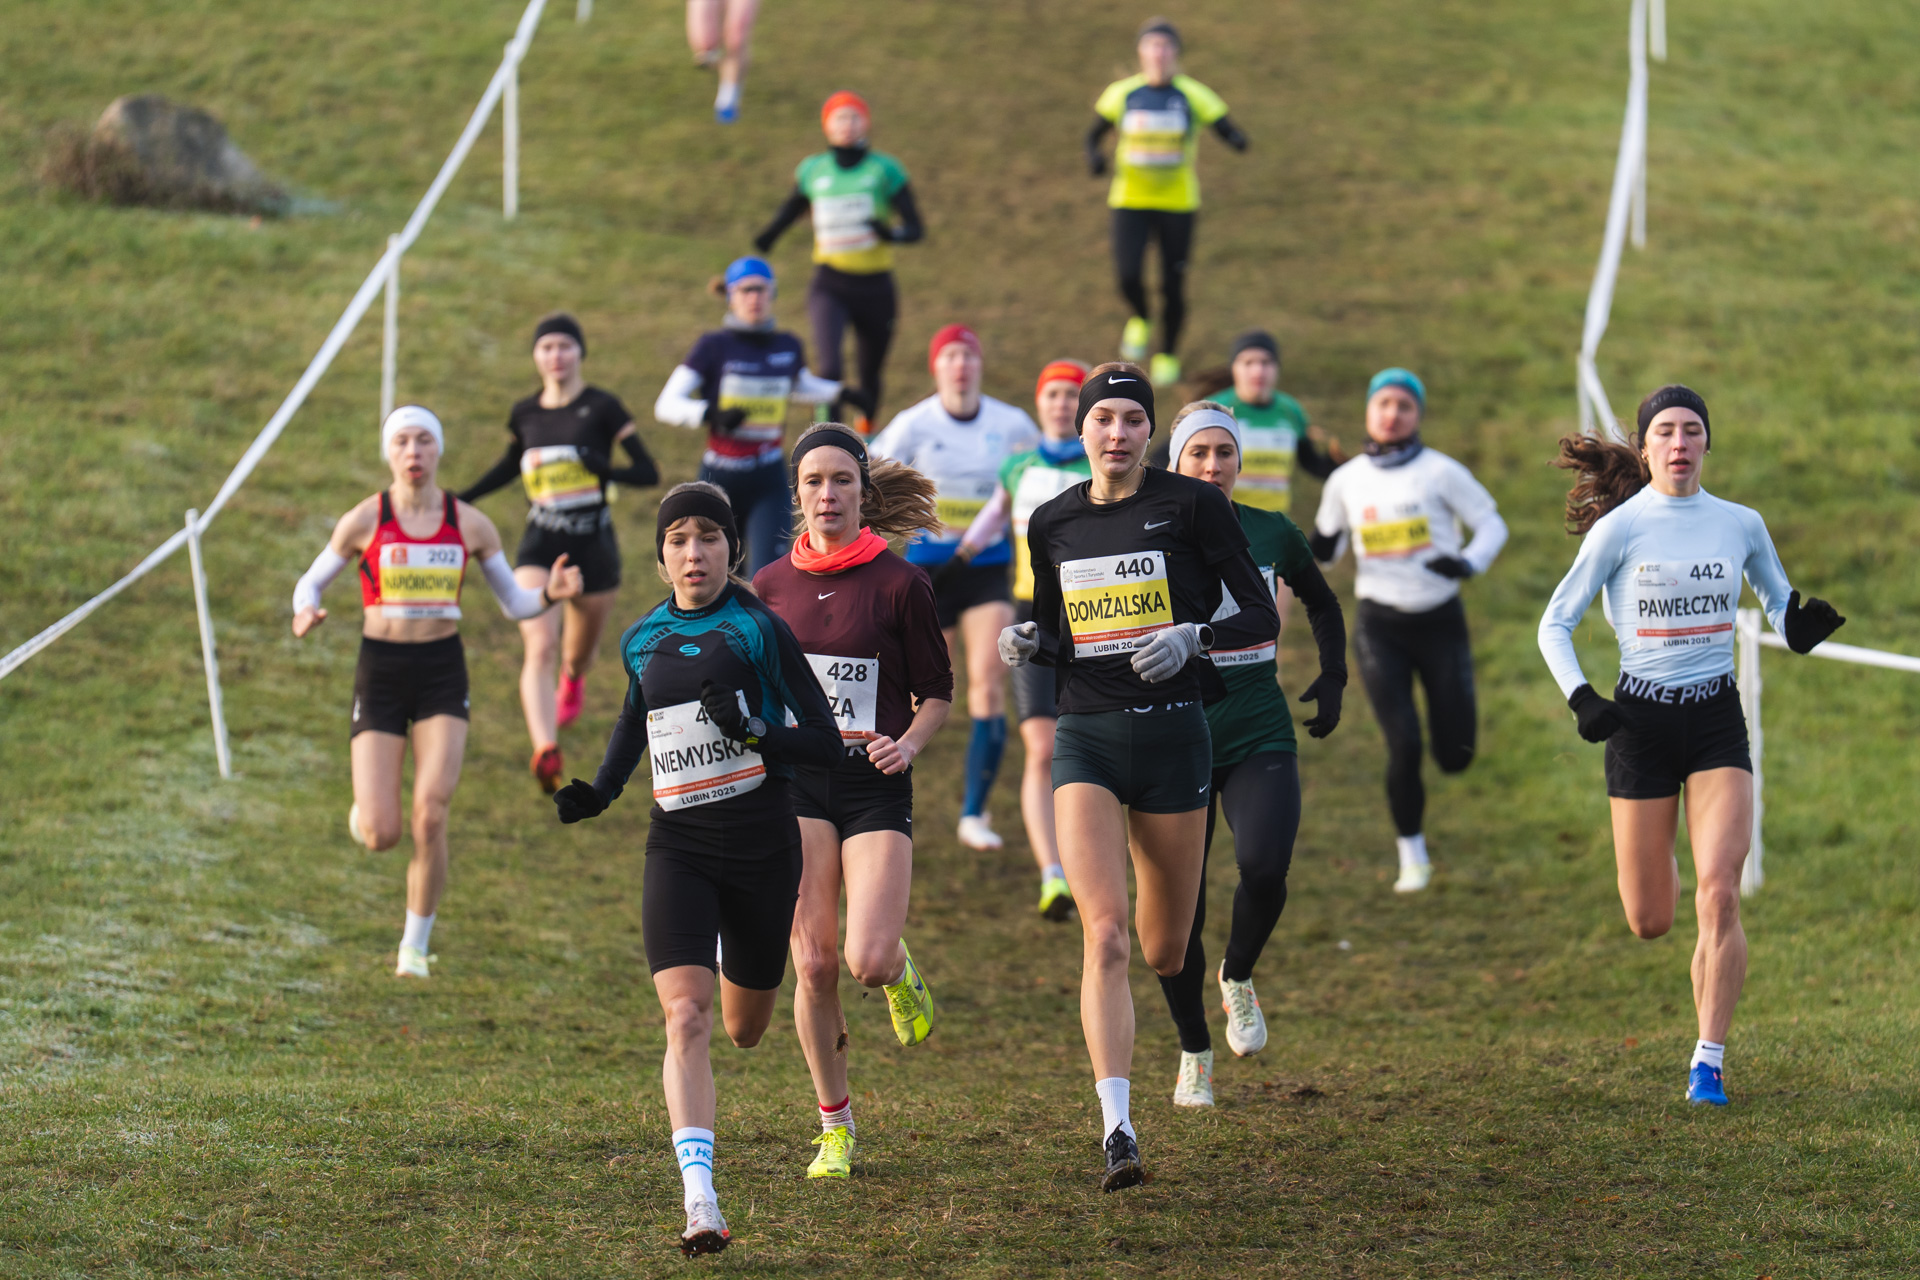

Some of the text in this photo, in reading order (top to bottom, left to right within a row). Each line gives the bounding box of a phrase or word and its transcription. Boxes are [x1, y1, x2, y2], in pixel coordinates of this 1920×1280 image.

[427, 548, 457, 564] 202
[1115, 557, 1154, 579] 440
[1690, 563, 1725, 581] 442
[1068, 590, 1166, 623] DOMŻALSKA
[1638, 593, 1730, 617] PAWEŁCZYK
[1093, 641, 1133, 653] LUBIN 20
[1664, 636, 1711, 647] LUBIN 2025
[1214, 653, 1259, 664] UBIN 2025
[827, 662, 868, 682] 428
[1623, 675, 1677, 704] NIKE
[1680, 678, 1721, 704] PRO
[681, 785, 737, 805] LUBIN 2025
